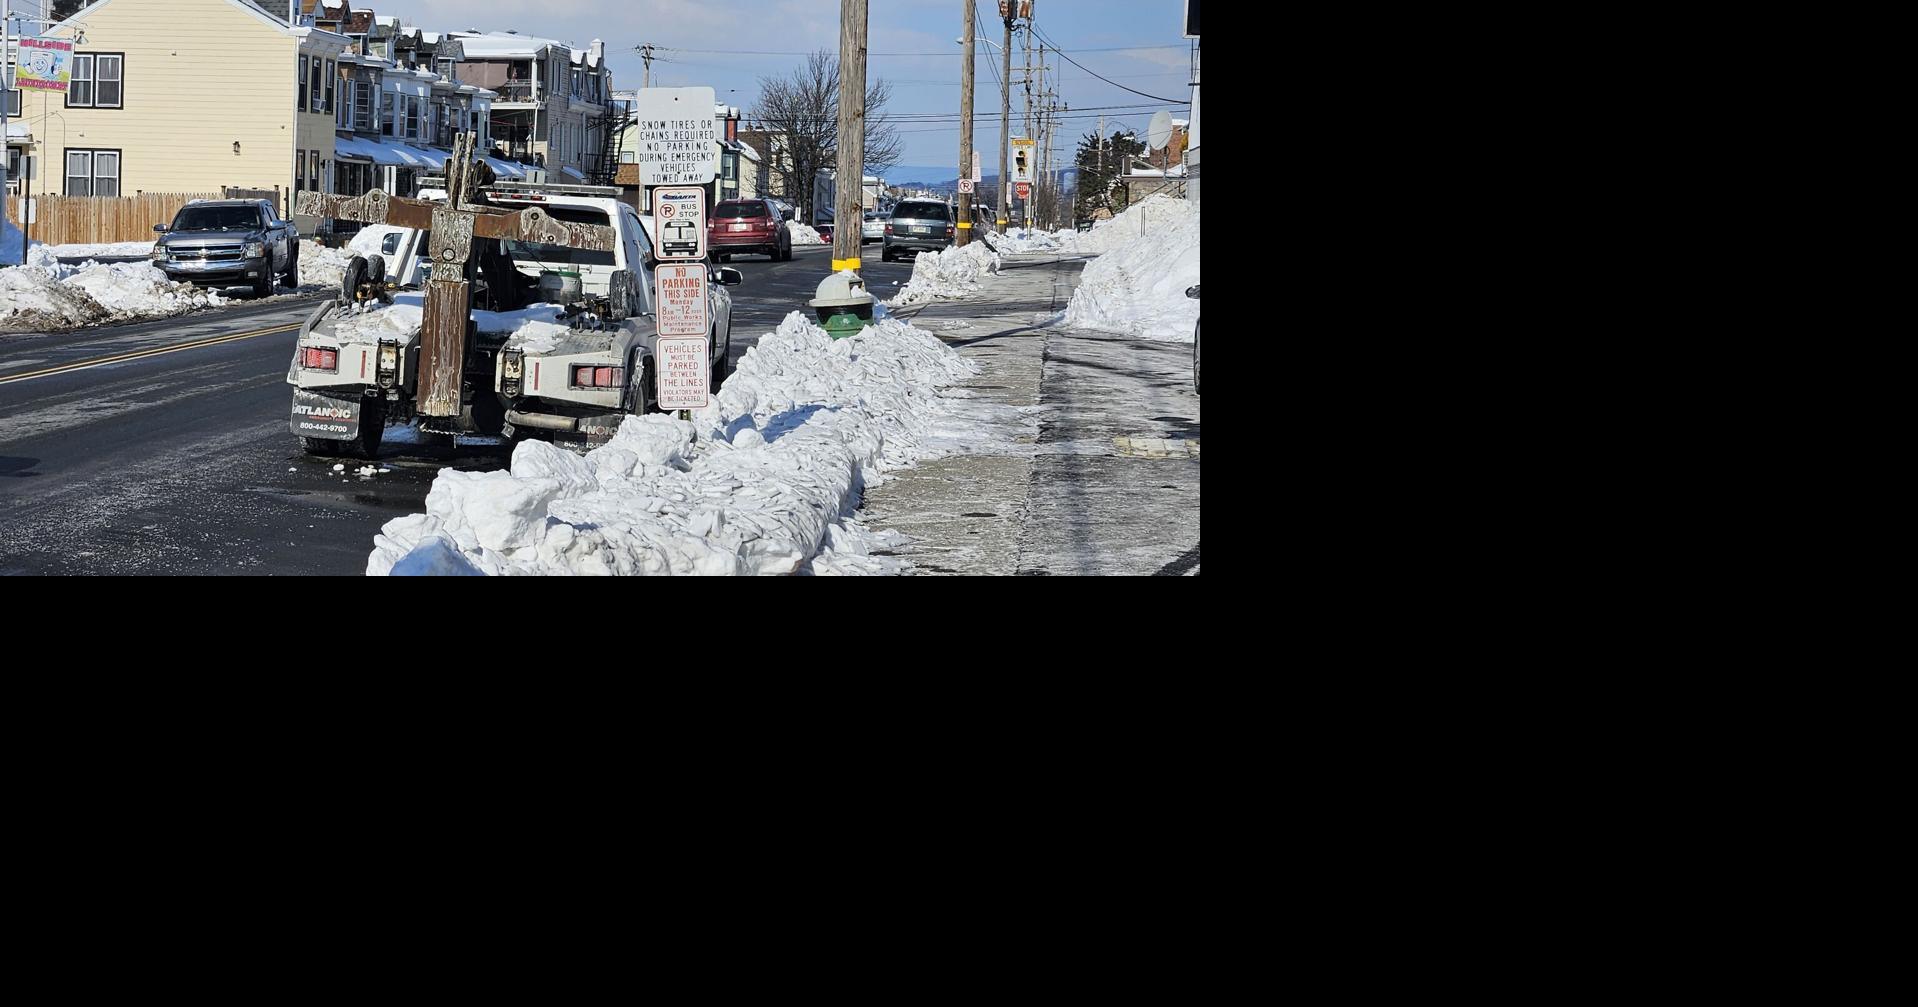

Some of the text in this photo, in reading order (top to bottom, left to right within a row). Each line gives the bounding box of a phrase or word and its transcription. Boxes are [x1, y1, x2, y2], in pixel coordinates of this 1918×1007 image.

[642, 120, 712, 130] SNOW TIRES OR
[640, 130, 714, 140] CHAINS REQUIRED
[647, 142, 708, 151] NO PARKING
[640, 152, 715, 162] DURING EMERGENCY
[660, 163, 696, 172] VEHICLES
[652, 174, 704, 183] TOWED AWAY
[676, 268, 686, 278] NO
[662, 278, 700, 288] PARKING
[664, 289, 700, 298] THIS SIDE
[664, 345, 702, 353] VEHICLES
[668, 362, 698, 370] PARKED
[664, 379, 678, 387] THE
[300, 422, 348, 432] 800-442-9700
